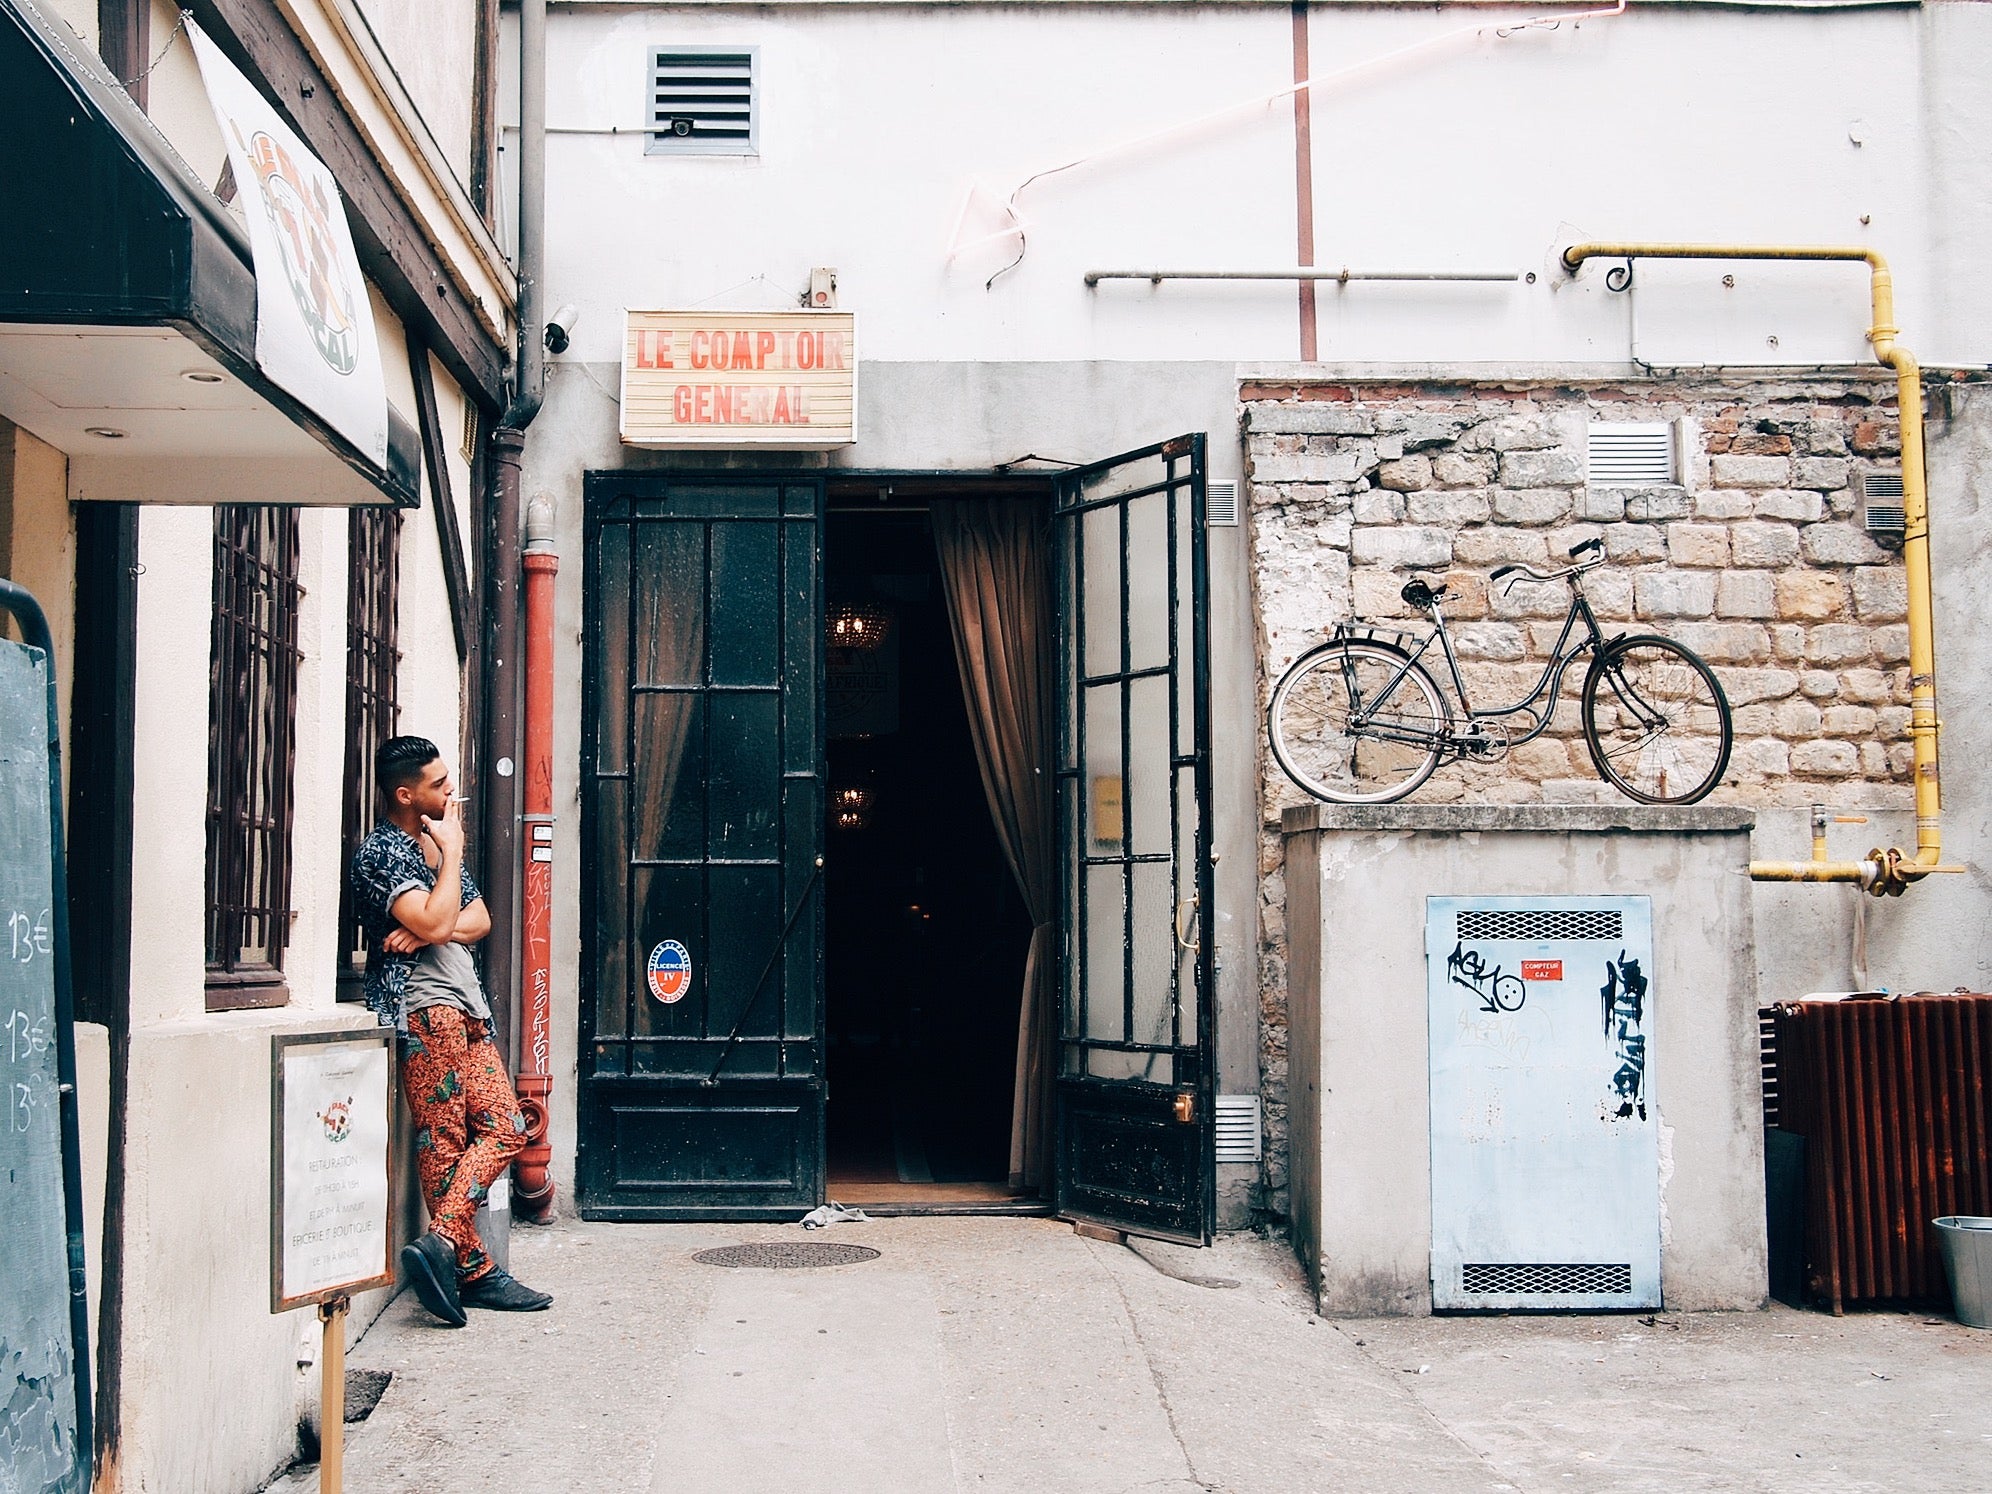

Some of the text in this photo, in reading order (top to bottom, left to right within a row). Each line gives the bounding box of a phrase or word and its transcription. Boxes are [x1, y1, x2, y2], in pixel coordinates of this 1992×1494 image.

[637, 330, 844, 369] LE COMPTOIR
[673, 385, 810, 423] GENERAL
[8, 908, 50, 963] 13€
[663, 972, 675, 981] IV
[4, 1008, 48, 1063] 13€
[332, 1220, 373, 1239] BOUTIQUE
